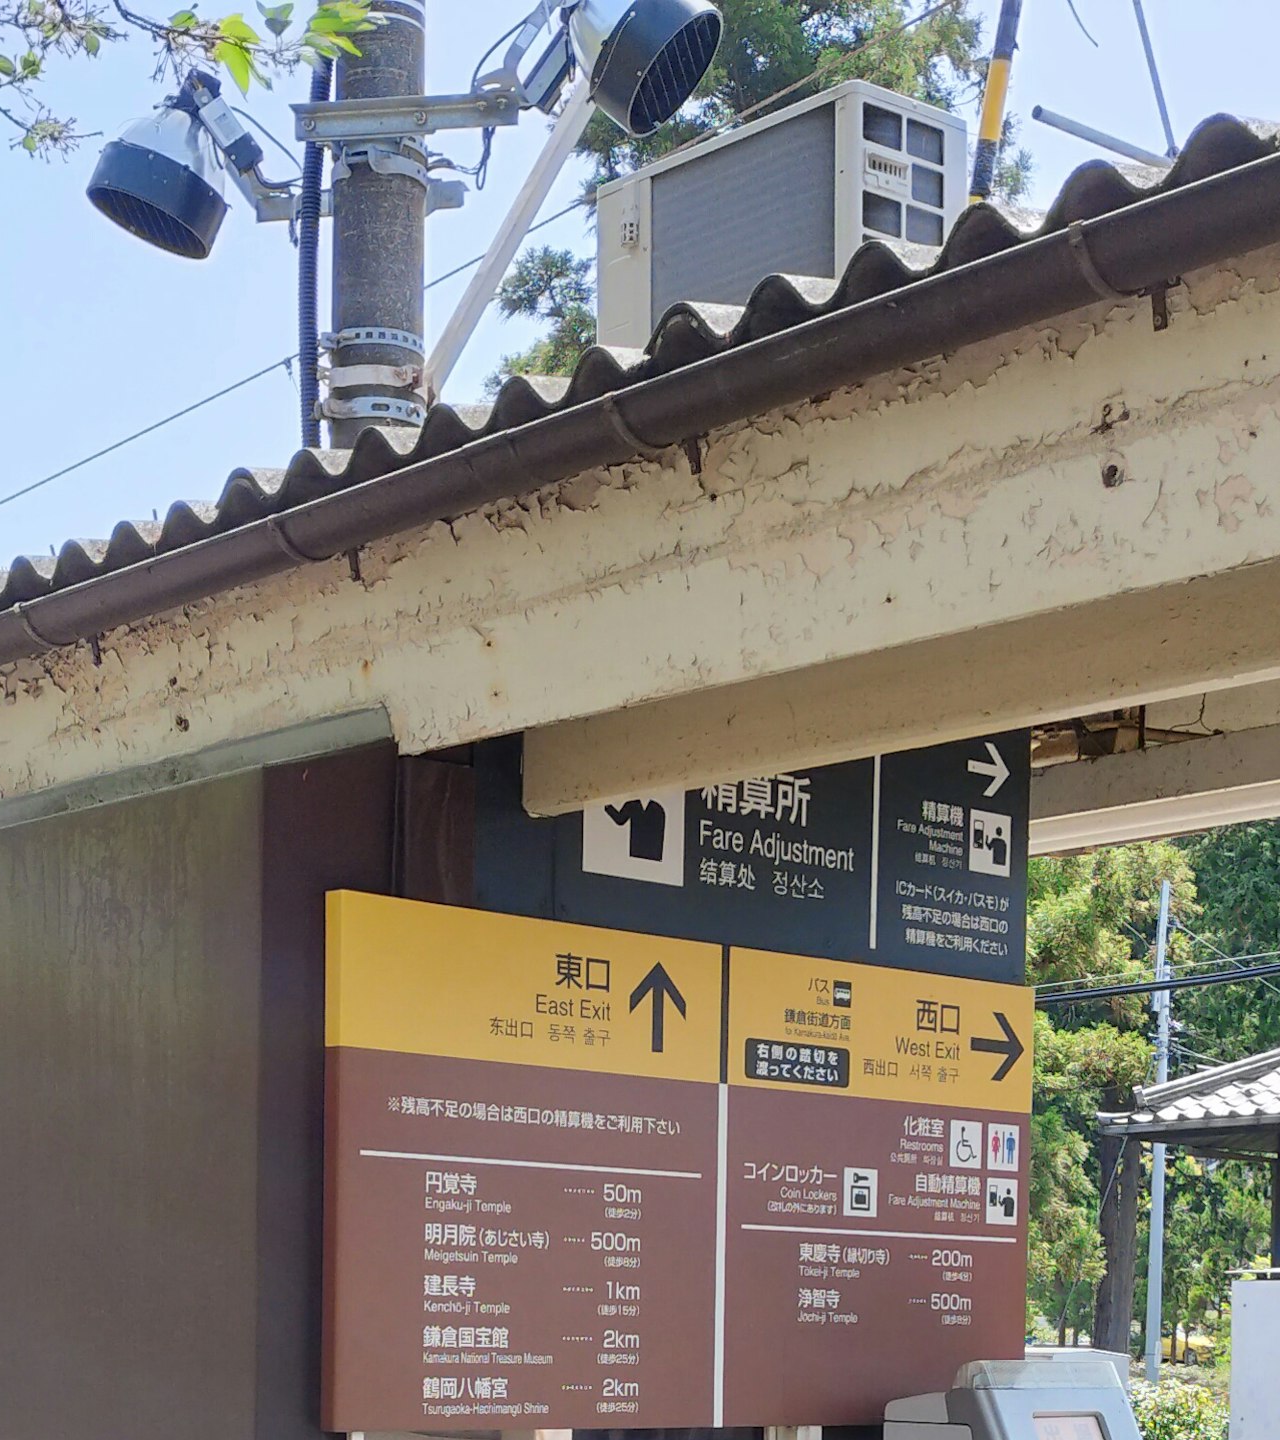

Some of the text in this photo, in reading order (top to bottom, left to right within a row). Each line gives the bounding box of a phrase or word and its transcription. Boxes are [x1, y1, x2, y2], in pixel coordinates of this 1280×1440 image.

[922, 800, 964, 827] 精算機
[897, 819, 964, 842] Fare Adjustment
[699, 819, 854, 872] Fare Adjustment
[929, 840, 963, 856] Machine
[902, 904, 1009, 934] 残高不足の場合は西口の
[905, 927, 1008, 956] 精算機をご利用ください
[555, 952, 610, 993] 東口
[808, 978, 830, 994] バス
[536, 994, 611, 1022] East Exit
[784, 1008, 851, 1030] 鎌倉街道方面
[916, 999, 961, 1035] 西口
[489, 1016, 534, 1039] 东出口
[757, 1043, 839, 1066] 右側の踏切を
[895, 1036, 961, 1061] West Exit
[756, 1060, 839, 1082] 渡ってください
[863, 1058, 898, 1077] 西出口
[904, 1115, 944, 1138] 化粧室
[900, 1139, 944, 1153] Restrooms
[743, 1162, 838, 1185] コインロッカー
[915, 1172, 981, 1196] 自動精算機
[425, 1171, 642, 1204] 円覚寺 50m
[780, 1186, 837, 1202] Coin Lockers
[425, 1197, 512, 1216] Engaku-ji Temple
[888, 1194, 981, 1211] Fare Adjustment Machine
[590, 1231, 641, 1252] 500m
[424, 1248, 518, 1266] Meigetsuin Temple
[931, 1249, 973, 1268] 200m
[830, 1266, 860, 1281] Temple
[424, 1275, 641, 1300] 建長寺 1km
[474, 1301, 511, 1318] Temple
[797, 1288, 972, 1311] 浄智寺 500m
[829, 1312, 859, 1325] Temple
[423, 1326, 640, 1349] 鎌倉国宝館 2km
[423, 1352, 553, 1365] Kamakura National Treasure Museum
[422, 1377, 639, 1400] 鶴岡八幡宮 2km
[523, 1403, 550, 1415] Shrine
